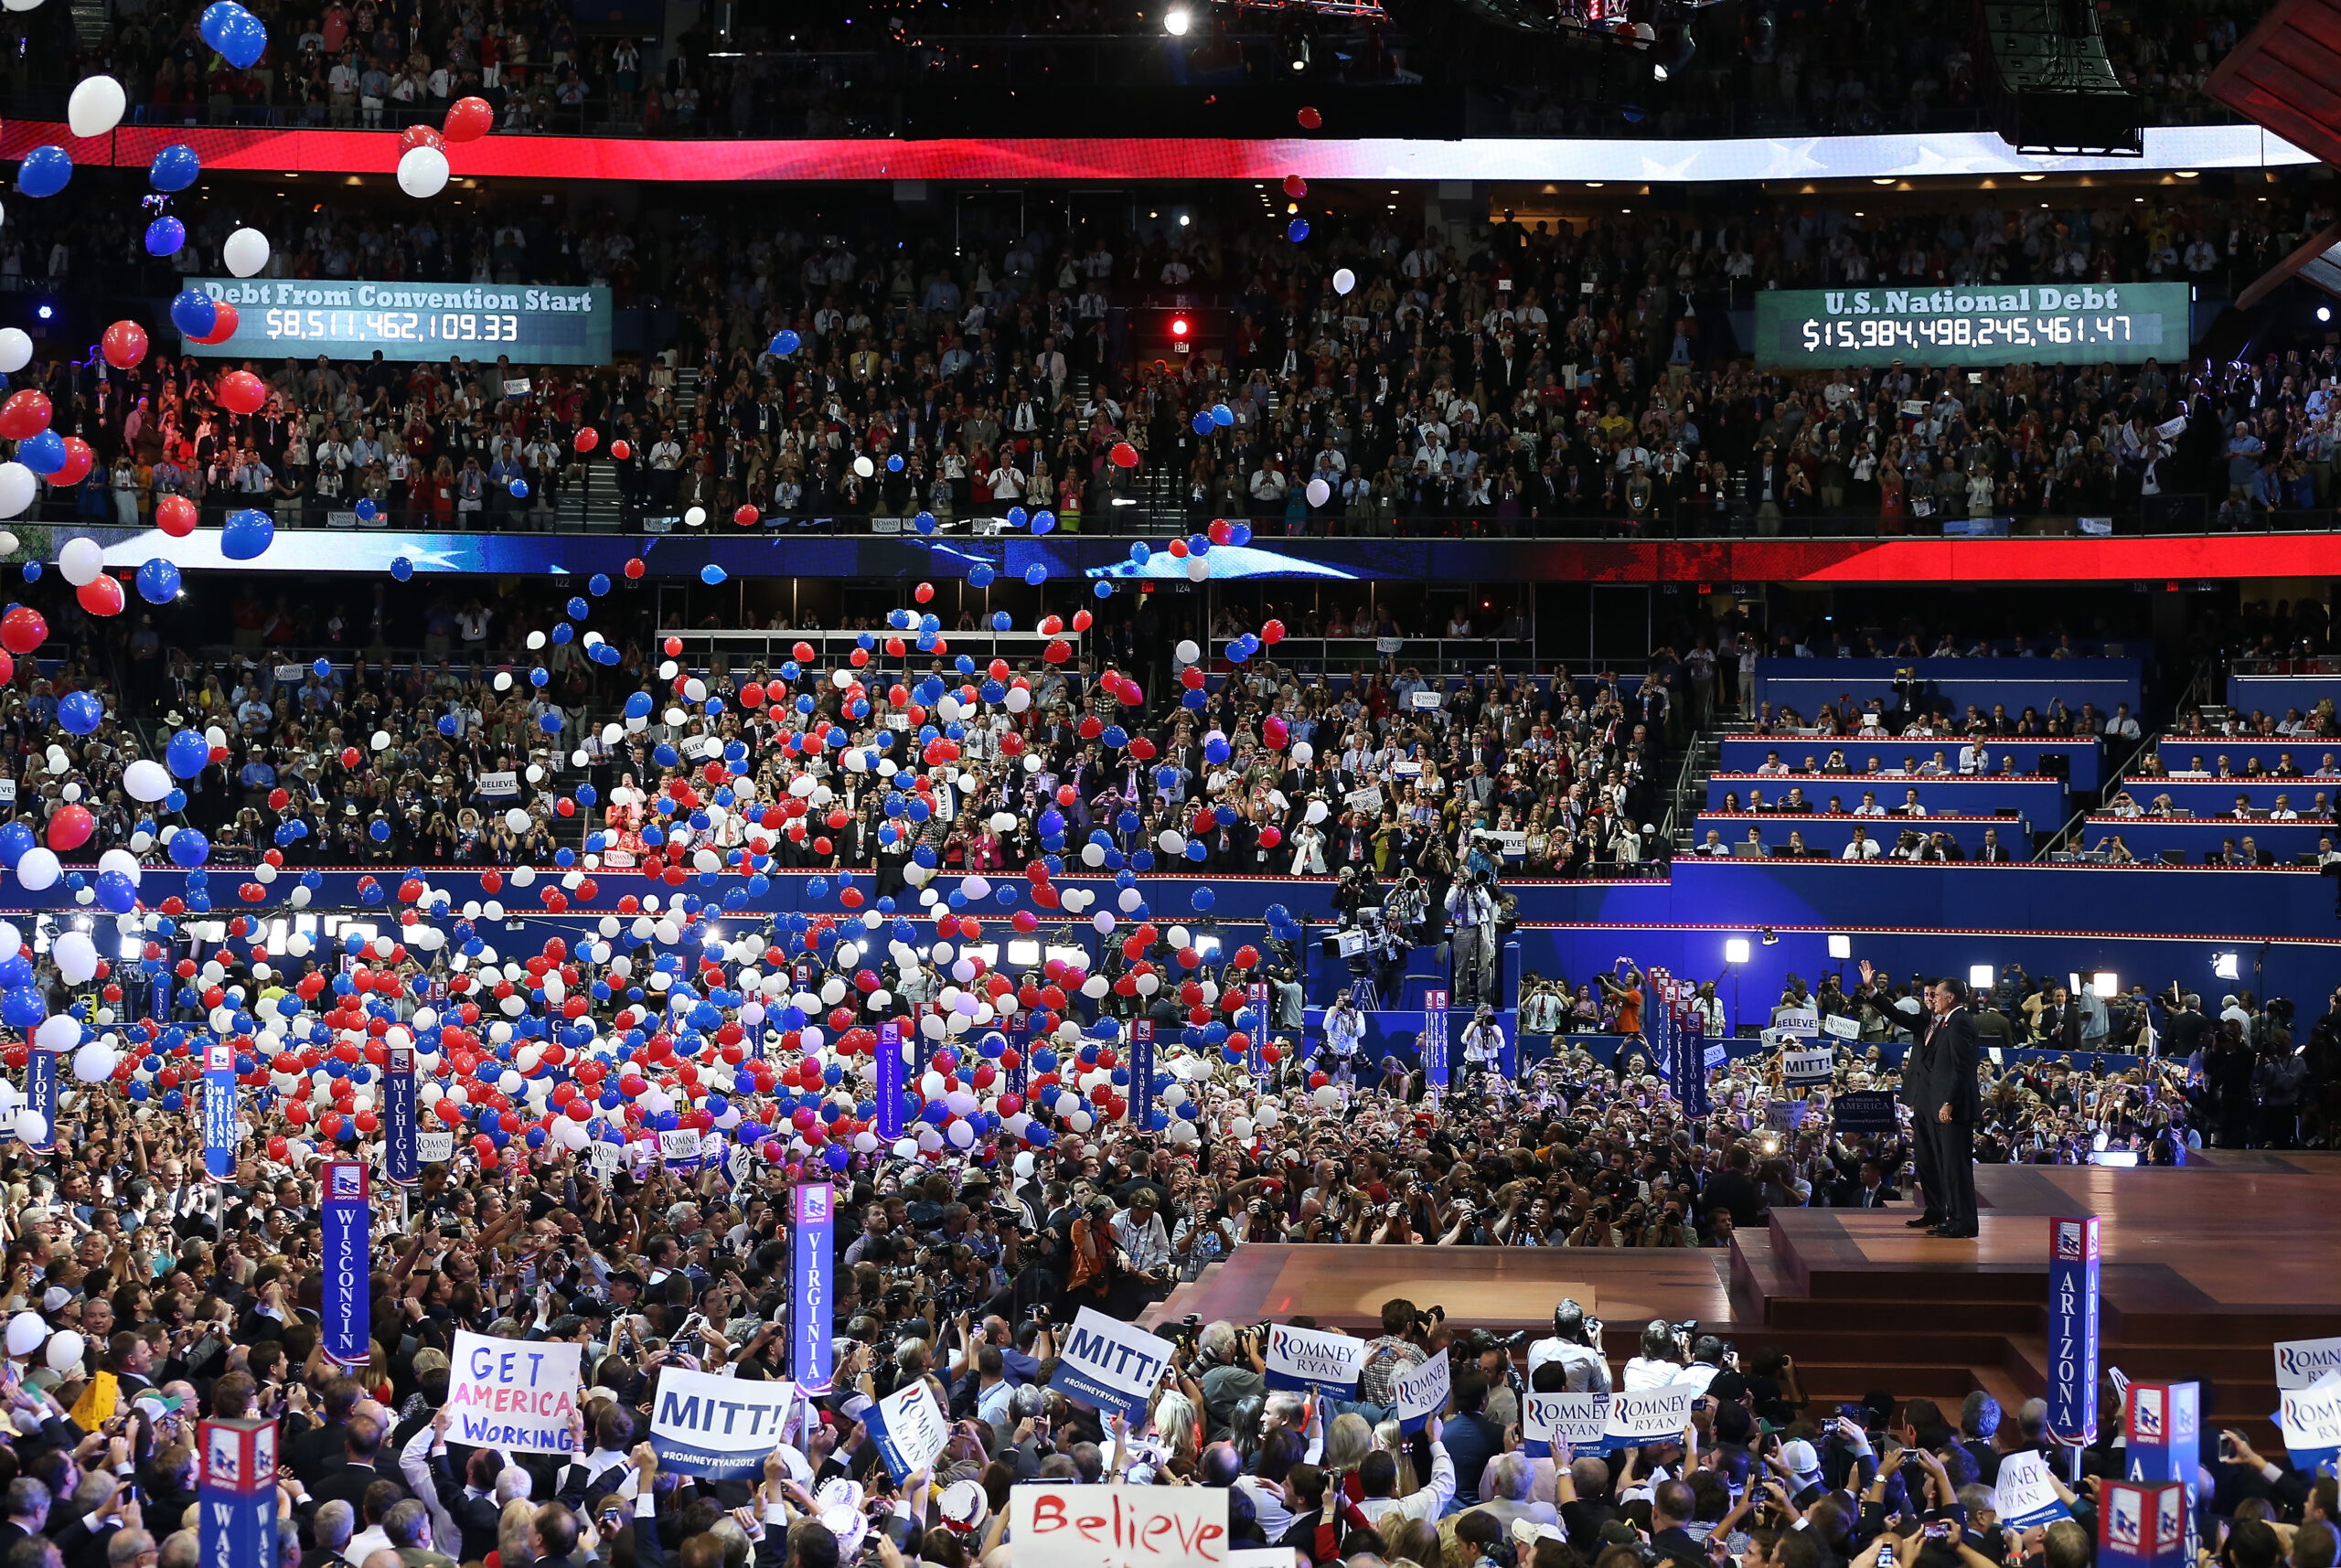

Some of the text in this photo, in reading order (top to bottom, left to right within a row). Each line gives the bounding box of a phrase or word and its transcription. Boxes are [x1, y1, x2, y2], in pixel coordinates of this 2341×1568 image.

[204, 281, 592, 312] Debt From Convention Start
[1824, 287, 2119, 315] U.S. National Debt
[266, 307, 518, 343] $8,511,462,109.33
[1802, 315, 2132, 352] $15,984,498,245,461.47
[873, 518, 899, 528] ROMNEY
[1175, 583, 1190, 592] 124
[1415, 693, 1439, 702] ROMNEY
[682, 741, 706, 752] ELIEV
[482, 780, 516, 789] BELIEVE!
[606, 852, 631, 862] ROMNE
[1503, 839, 1524, 848] IEVE!
[1250, 1004, 1258, 1071] GRGIA
[1777, 1018, 1818, 1029] BELIEVE!
[1827, 1015, 1856, 1031] ROMNEY
[1018, 1044, 1026, 1095] ISLAND
[1689, 1036, 1698, 1114] PUERTO RICO
[1785, 1057, 1830, 1073] MITT!
[885, 1049, 894, 1133] MASSACHUSETTS
[1138, 1067, 1146, 1125] HAMPSHIRE
[1838, 1102, 1889, 1110] AMERICA
[206, 1077, 214, 1148] NORTHERN
[215, 1085, 225, 1148] MARIANA
[226, 1095, 235, 1157] ISLANDS
[393, 1079, 407, 1173] MICHIGAN
[426, 1150, 447, 1158] RYAN
[675, 1145, 696, 1155] RYAN
[336, 1209, 358, 1349] WISCONSIN
[807, 1232, 821, 1380] VIRGINIA
[1068, 1328, 1161, 1389] MITT!
[1273, 1329, 1357, 1363] ROMNEY
[2057, 1271, 2076, 1427] ARIZONA
[2088, 1271, 2096, 1426] ARIZONA
[2279, 1347, 2341, 1376] ROMN
[470, 1346, 545, 1387] GET
[1297, 1360, 1342, 1377] RYAN
[1398, 1359, 1447, 1405] ROMNEY
[454, 1383, 572, 1419] AMERICA
[1419, 1382, 1445, 1409] RYAN
[1528, 1398, 1609, 1427] ROMNEY
[1613, 1393, 1688, 1424] ROMNEY
[657, 1391, 783, 1436] MITT!
[899, 1385, 941, 1457] ROMNEY
[1555, 1424, 1600, 1435] RYAN
[1633, 1416, 1678, 1432] RYAN
[2284, 1399, 2341, 1433] ROM
[896, 1423, 925, 1463] RYAN
[2317, 1424, 2341, 1440] RY
[661, 1450, 755, 1468] #ROMNEYRYAN2012
[1032, 1493, 1224, 1563] Believe
